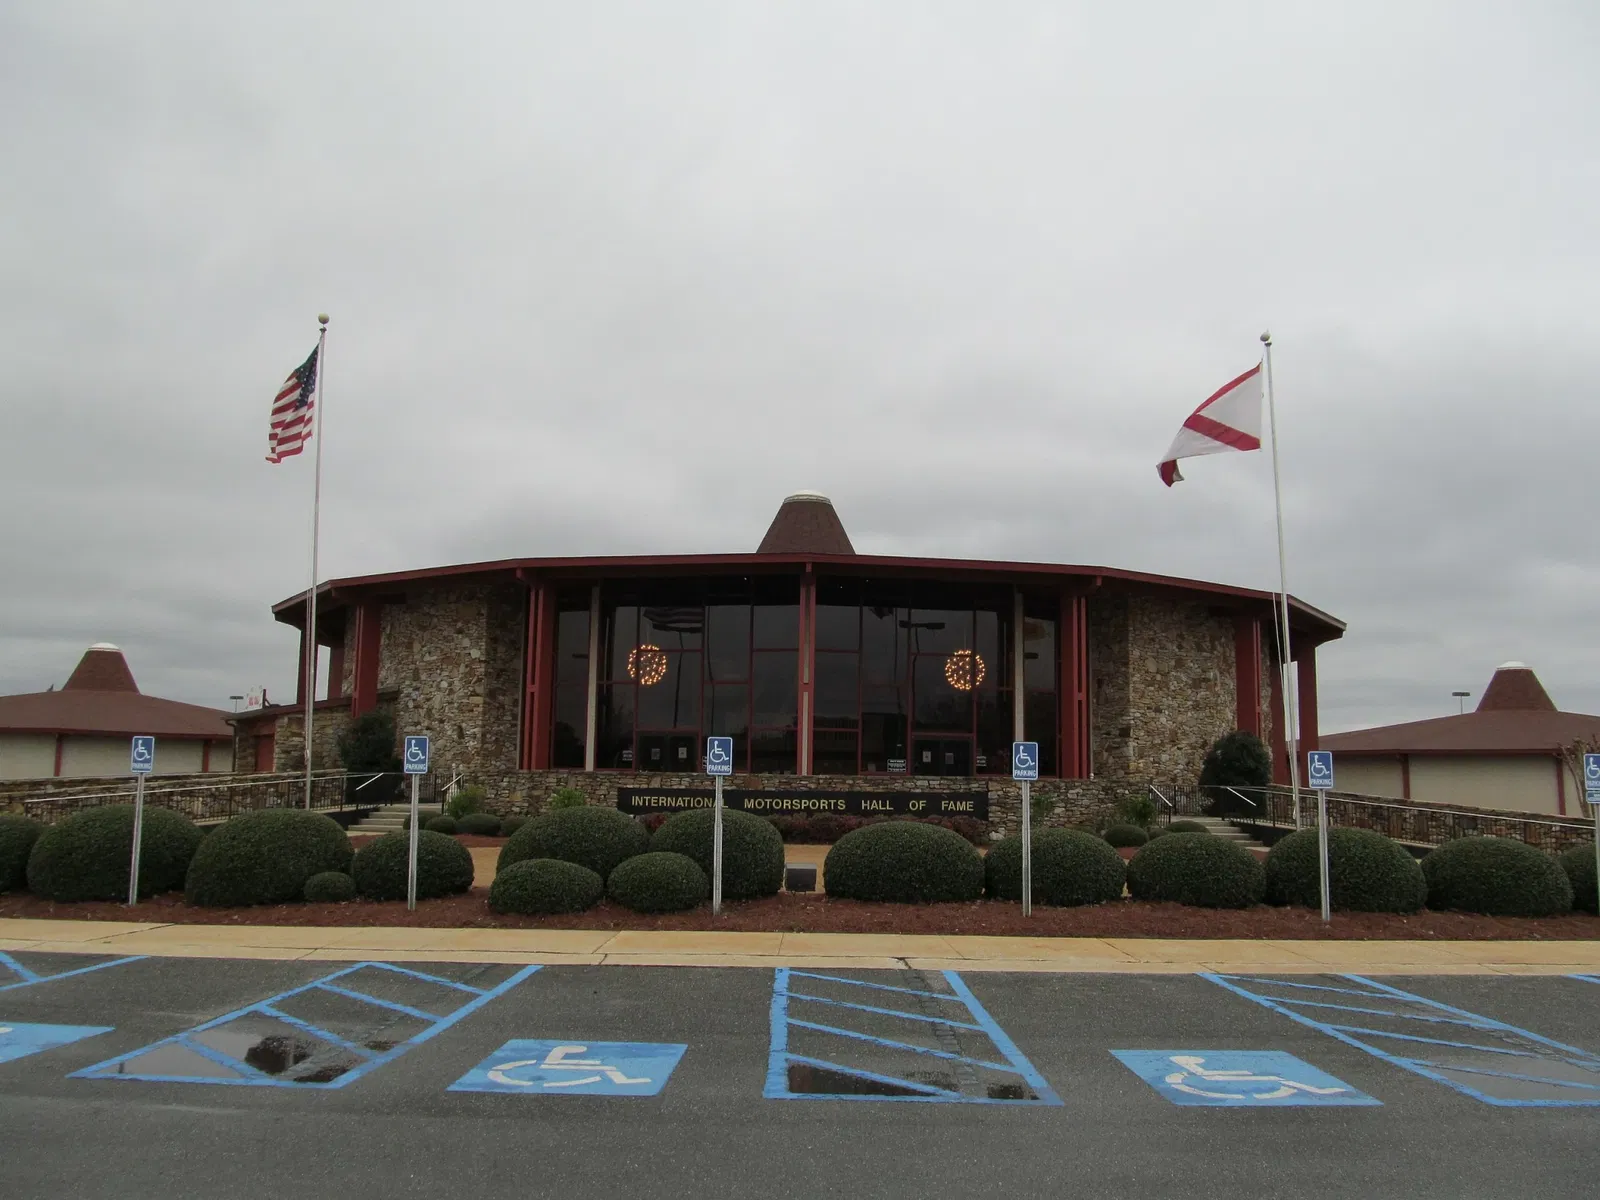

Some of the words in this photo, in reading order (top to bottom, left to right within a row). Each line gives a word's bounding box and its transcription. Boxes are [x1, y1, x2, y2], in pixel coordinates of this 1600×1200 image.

[744, 798, 846, 810] MOTORSPORTS
[861, 799, 894, 811] HALL
[909, 800, 927, 811] OF
[941, 800, 974, 812] FAME
